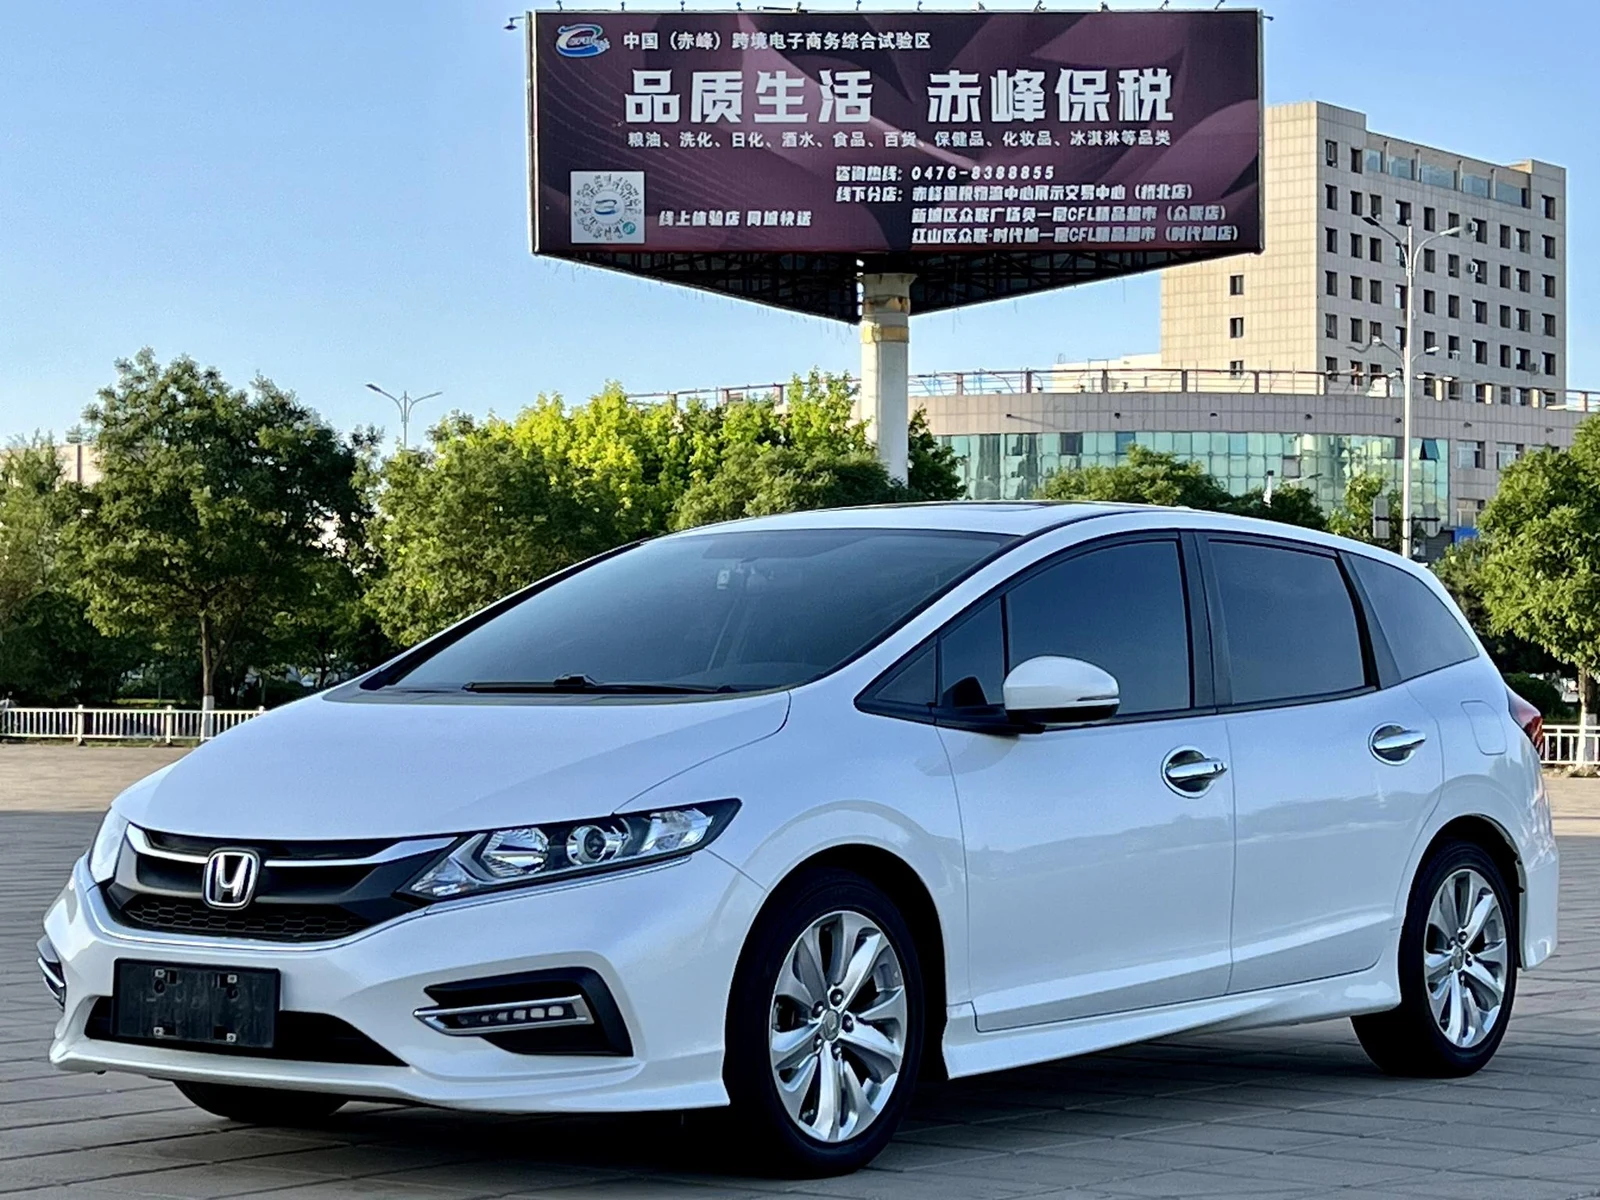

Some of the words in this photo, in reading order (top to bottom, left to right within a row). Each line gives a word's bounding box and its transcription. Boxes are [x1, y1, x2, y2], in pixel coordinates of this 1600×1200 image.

[624, 68, 873, 123] 品质生活
[927, 67, 1174, 123] 赤峰保税
